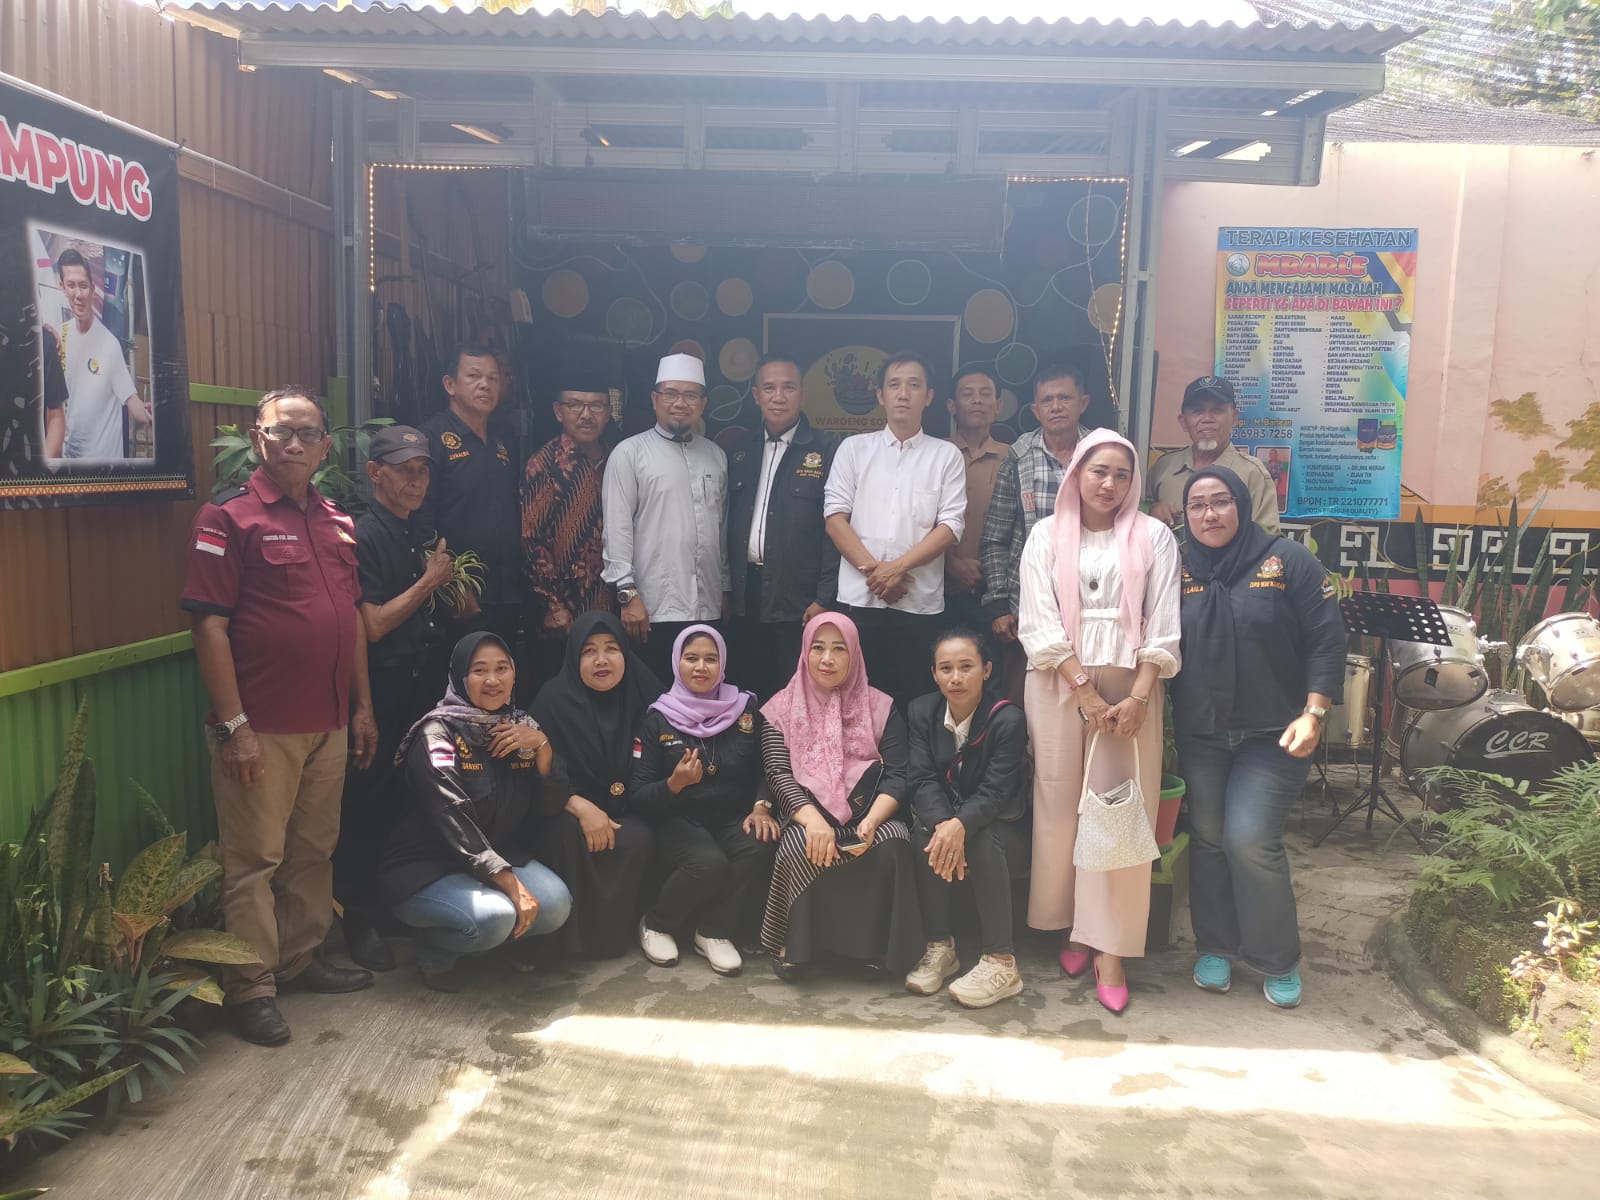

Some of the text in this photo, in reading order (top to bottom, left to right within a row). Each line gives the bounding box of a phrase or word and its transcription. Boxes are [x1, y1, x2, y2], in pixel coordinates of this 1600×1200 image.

[1227, 230, 1411, 247] TERAPI KESEHATAN
[1226, 282, 1383, 295] ANDA MENGALAMI MASALAH
[1224, 297, 1271, 312] SEPERTI
[1291, 297, 1315, 312] ADA
[1317, 297, 1330, 312] DI
[1332, 297, 1373, 312] BAWAH
[1375, 297, 1393, 312] INI
[815, 416, 868, 426] WAROENG
[1240, 428, 1266, 438] 6983
[1268, 428, 1292, 438] 7258
[1296, 497, 1322, 505] BPOM
[1328, 497, 1339, 505] TR
[1342, 498, 1388, 506] 221077771
[1485, 730, 1550, 753] CCR
